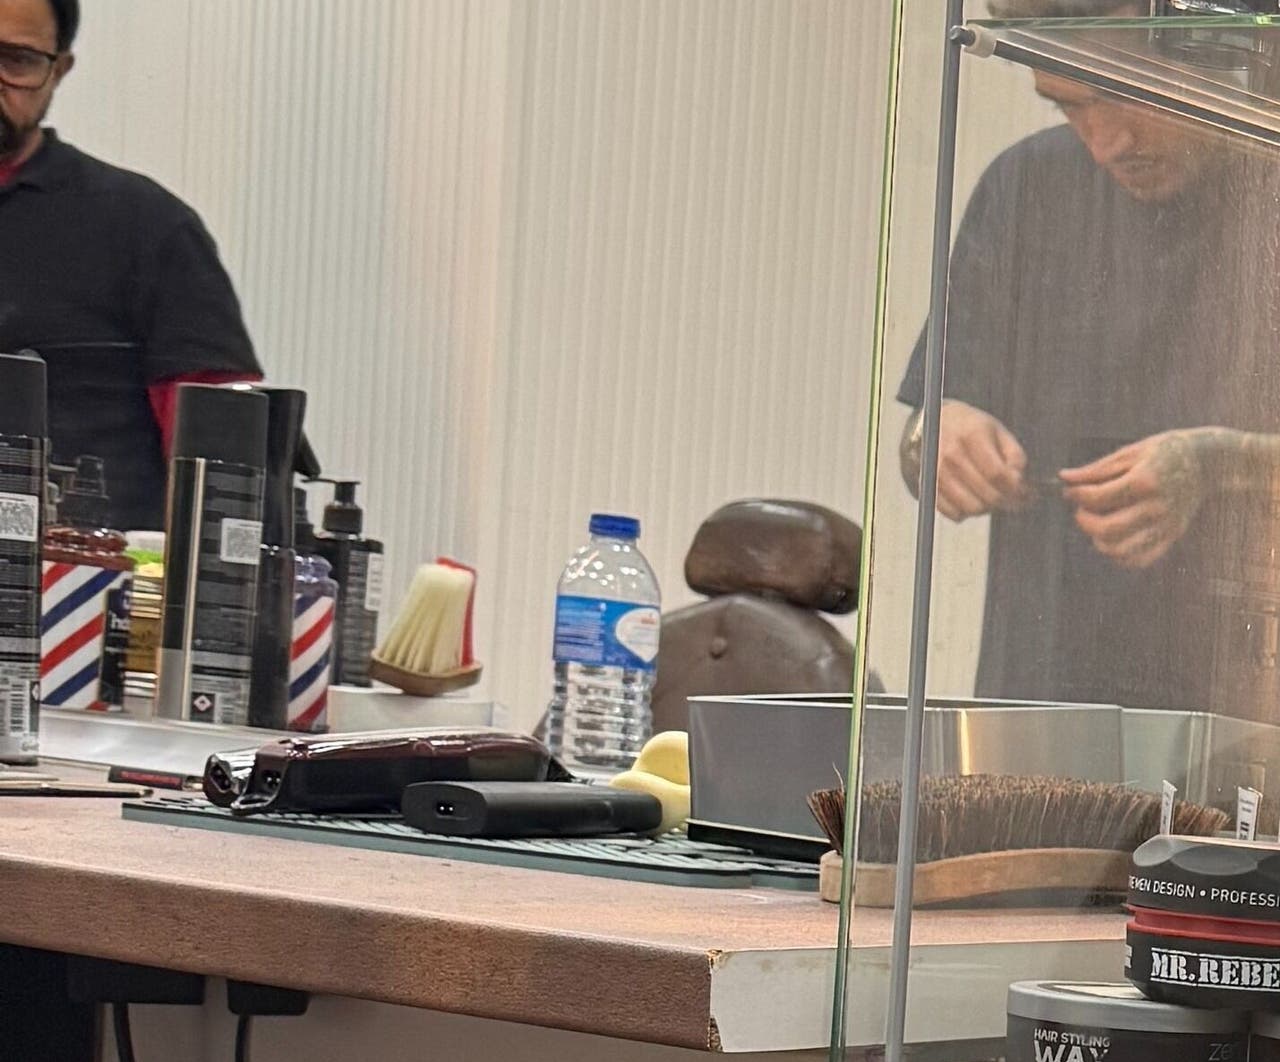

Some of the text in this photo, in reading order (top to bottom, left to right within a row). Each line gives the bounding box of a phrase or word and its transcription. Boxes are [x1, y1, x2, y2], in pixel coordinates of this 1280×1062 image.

[1153, 881, 1195, 898] DESIGN
[1034, 1028, 1110, 1048] HAIR STYLING
